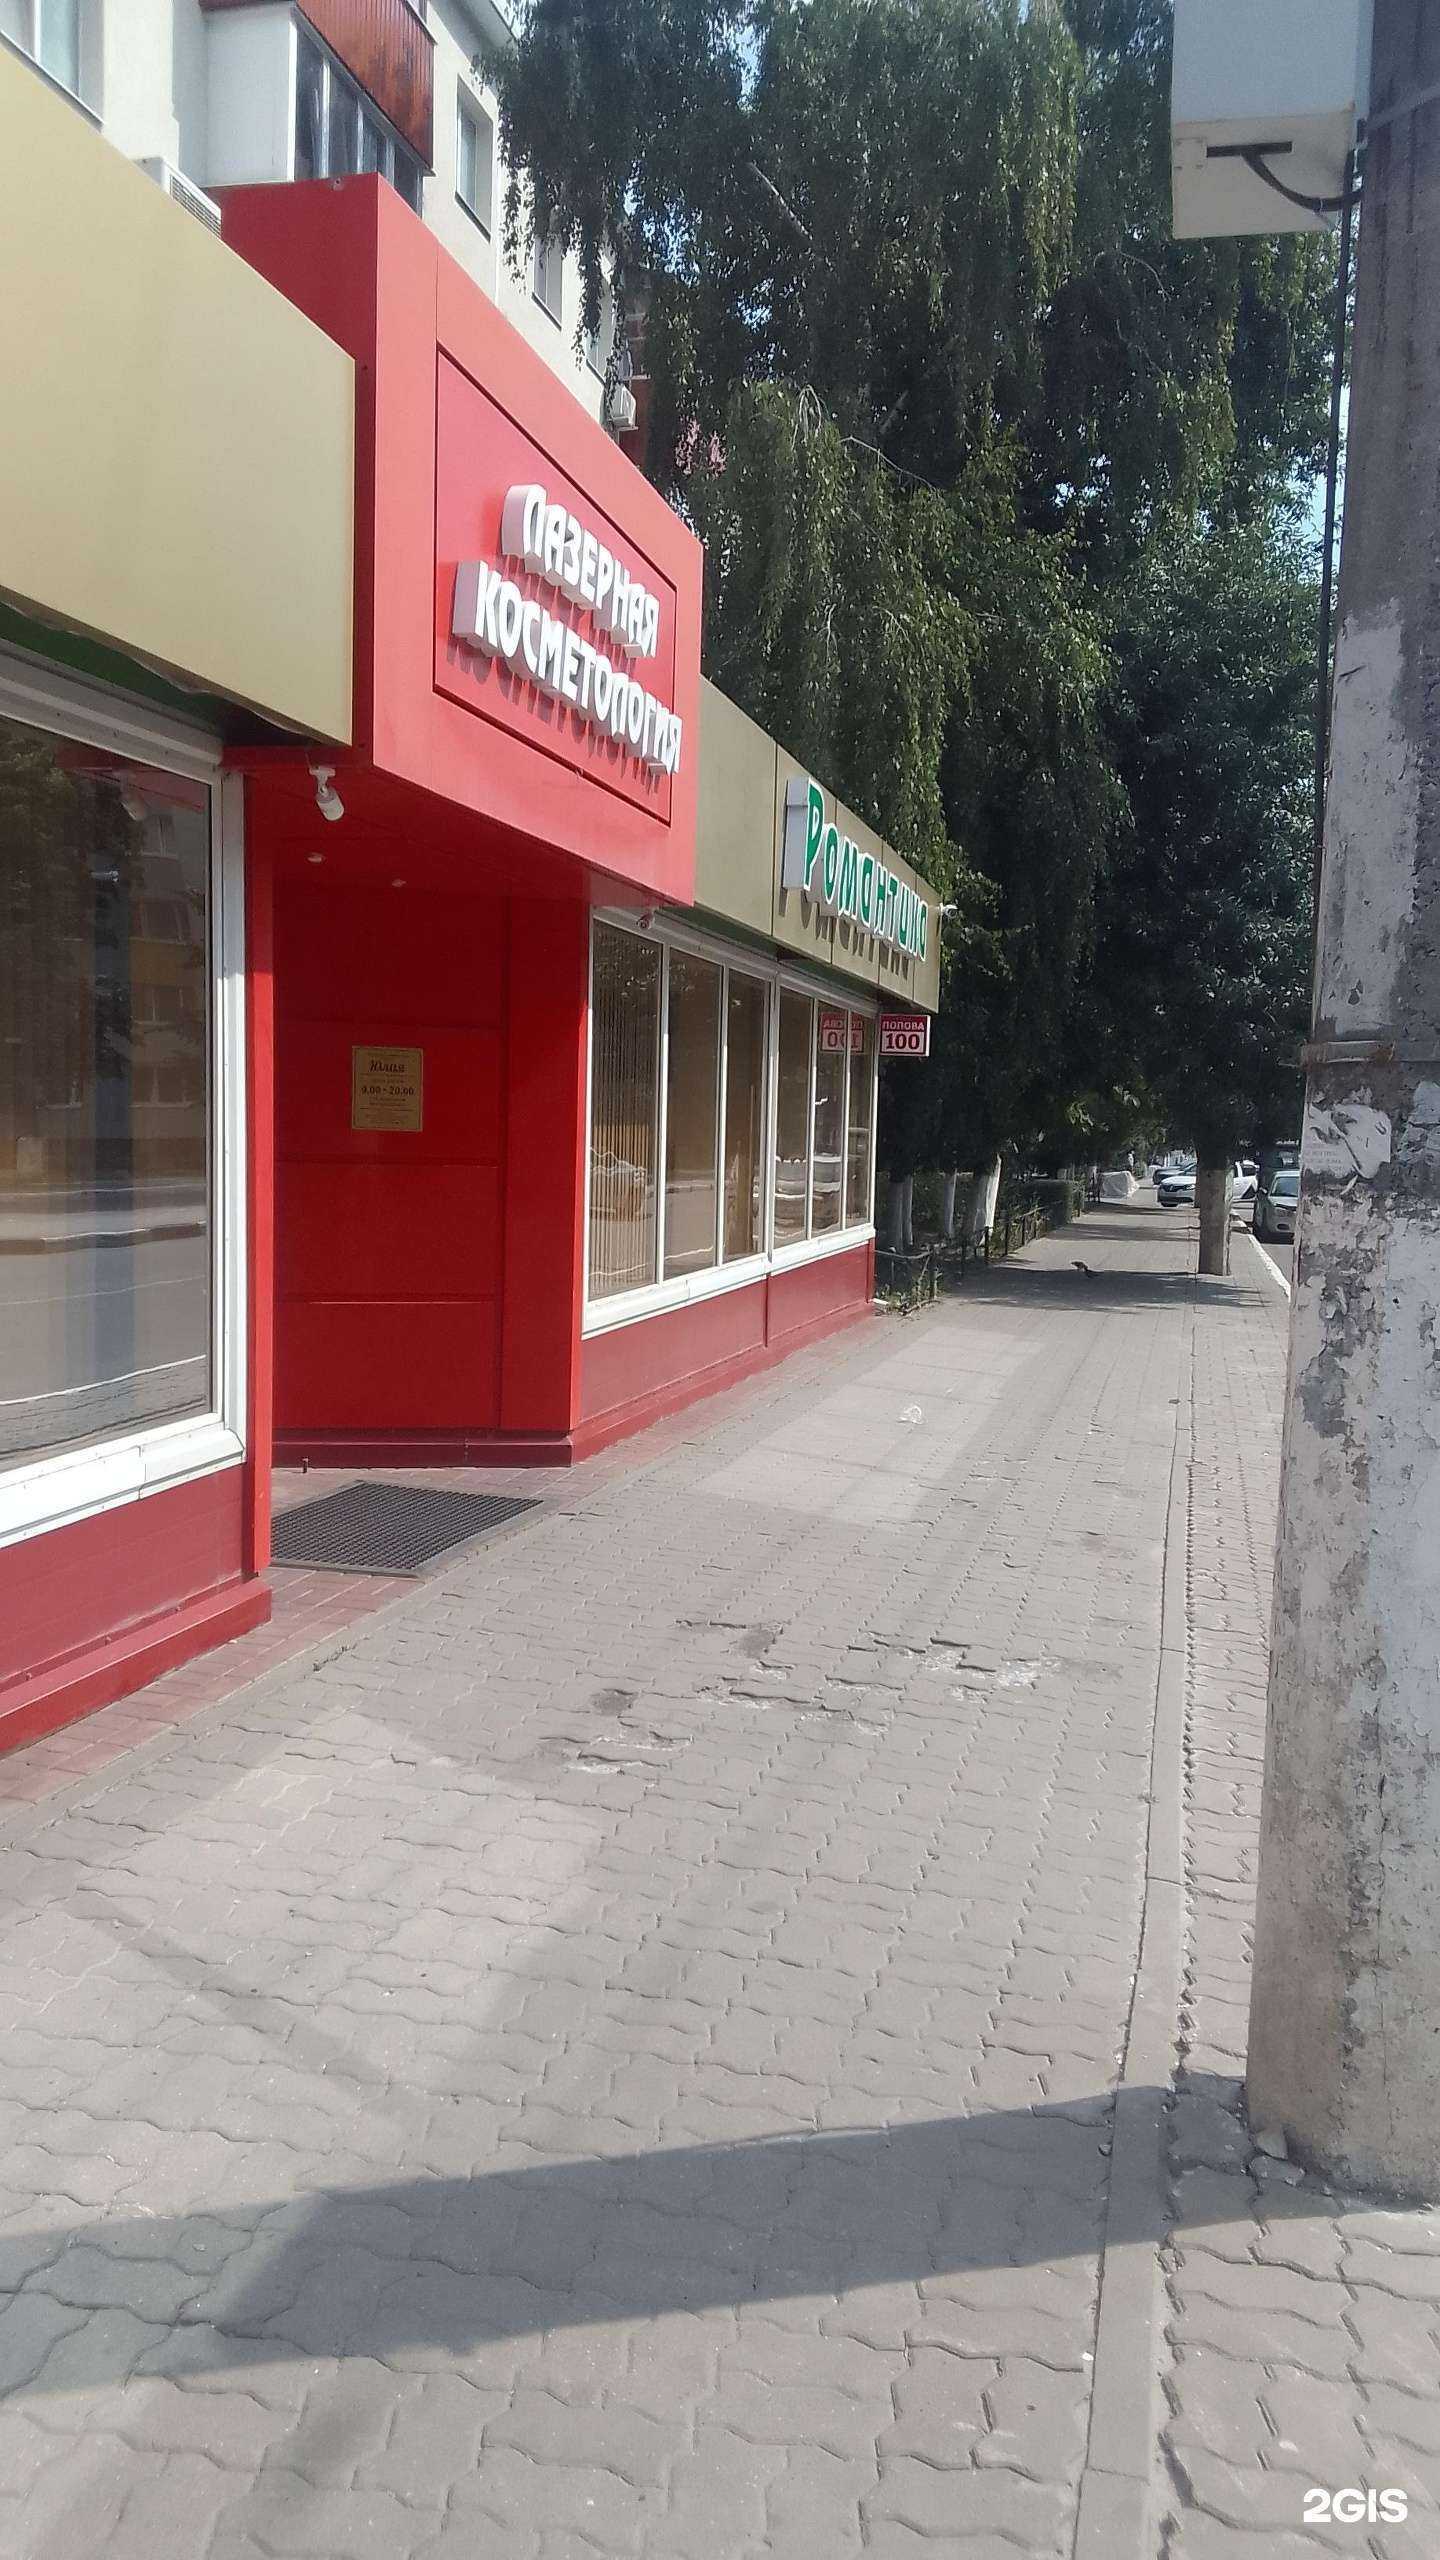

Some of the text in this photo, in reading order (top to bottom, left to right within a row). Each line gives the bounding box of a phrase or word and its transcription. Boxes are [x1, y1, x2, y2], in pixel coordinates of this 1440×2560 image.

[504, 484, 659, 657] ЛАЗЕРНАЯ
[456, 560, 682, 774] КОСМЕТОЛОГИЯ
[882, 1021, 925, 1031] ПОПОВА
[886, 1033, 920, 1049] 100
